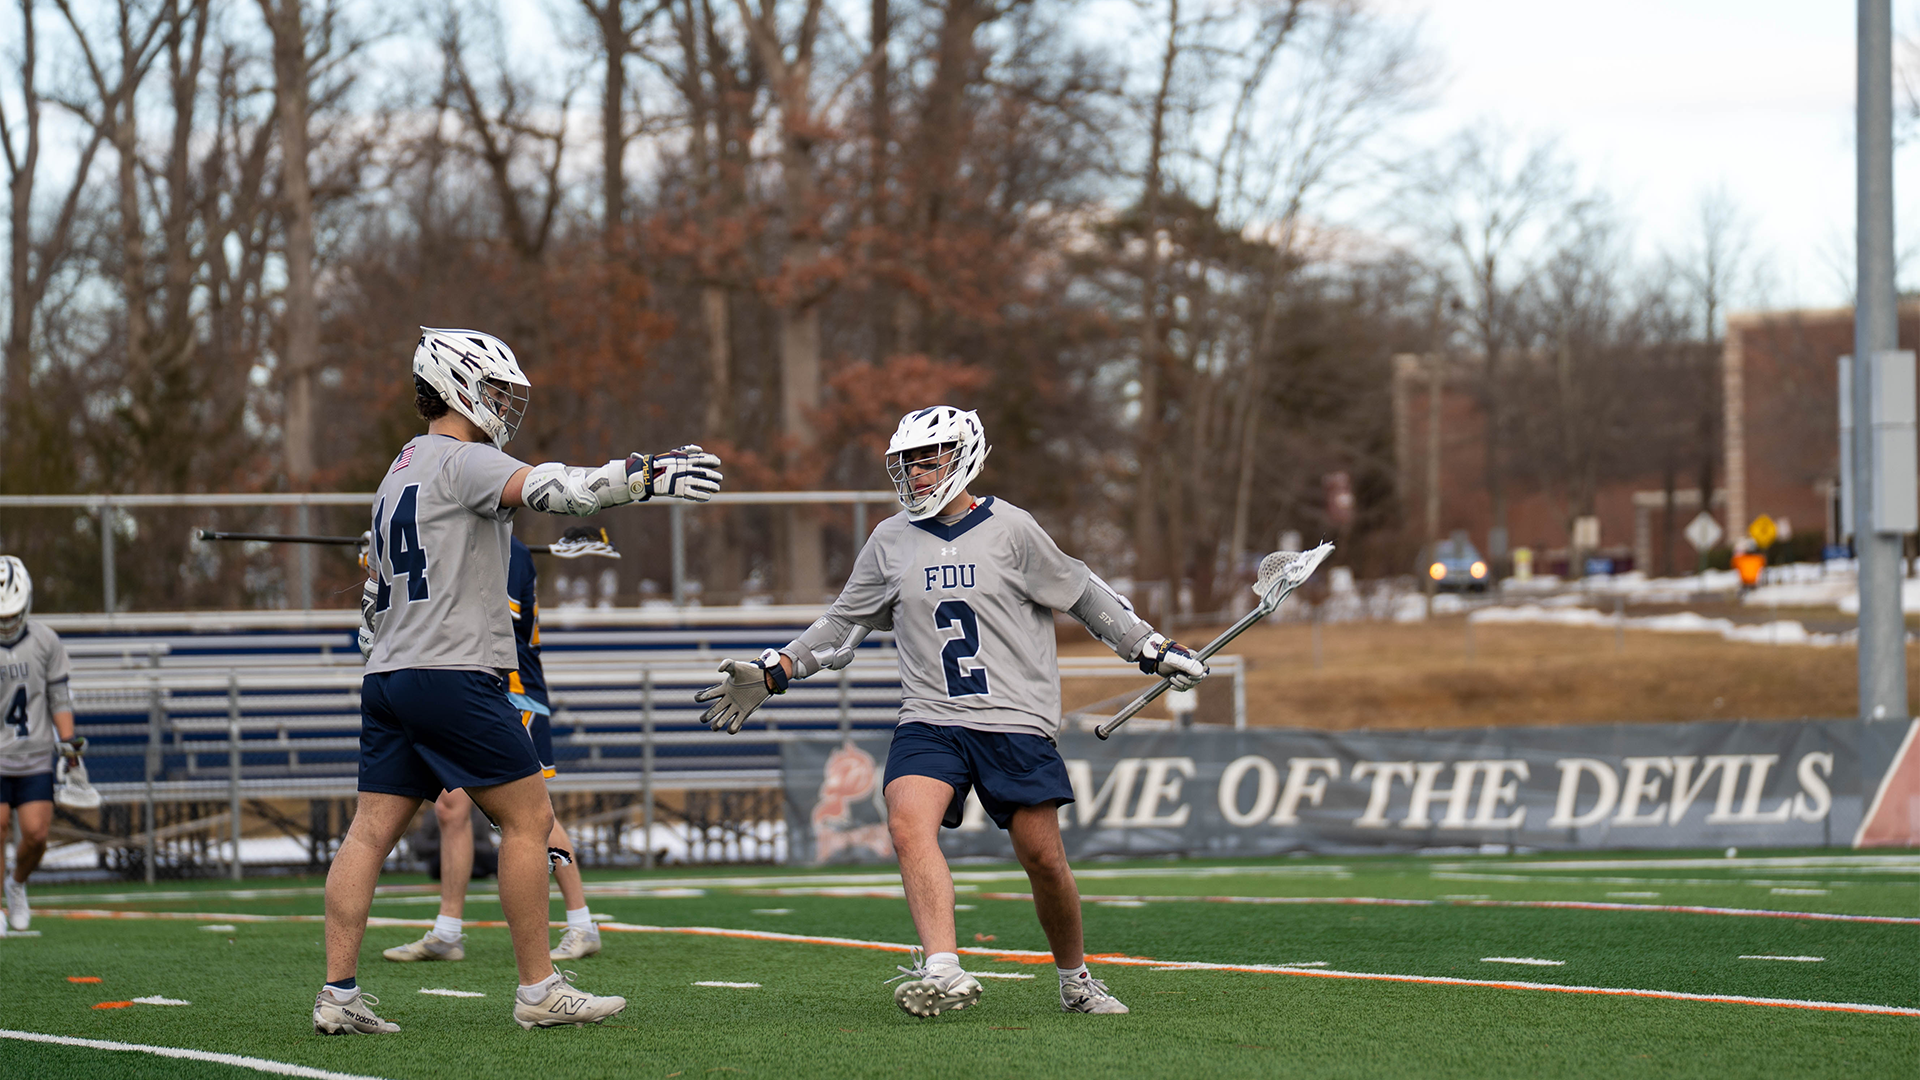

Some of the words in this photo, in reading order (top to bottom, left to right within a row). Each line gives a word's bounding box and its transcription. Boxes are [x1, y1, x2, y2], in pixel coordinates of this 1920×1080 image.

[923, 563, 977, 591] FDU
[1098, 611, 1115, 626] STX
[932, 597, 991, 699] 2
[4, 683, 30, 739] 4
[1217, 754, 1341, 828] OF
[1351, 759, 1531, 830] THE
[1546, 751, 1834, 829] DEVILS
[341, 1006, 357, 1019] new
[549, 994, 588, 1016] N
